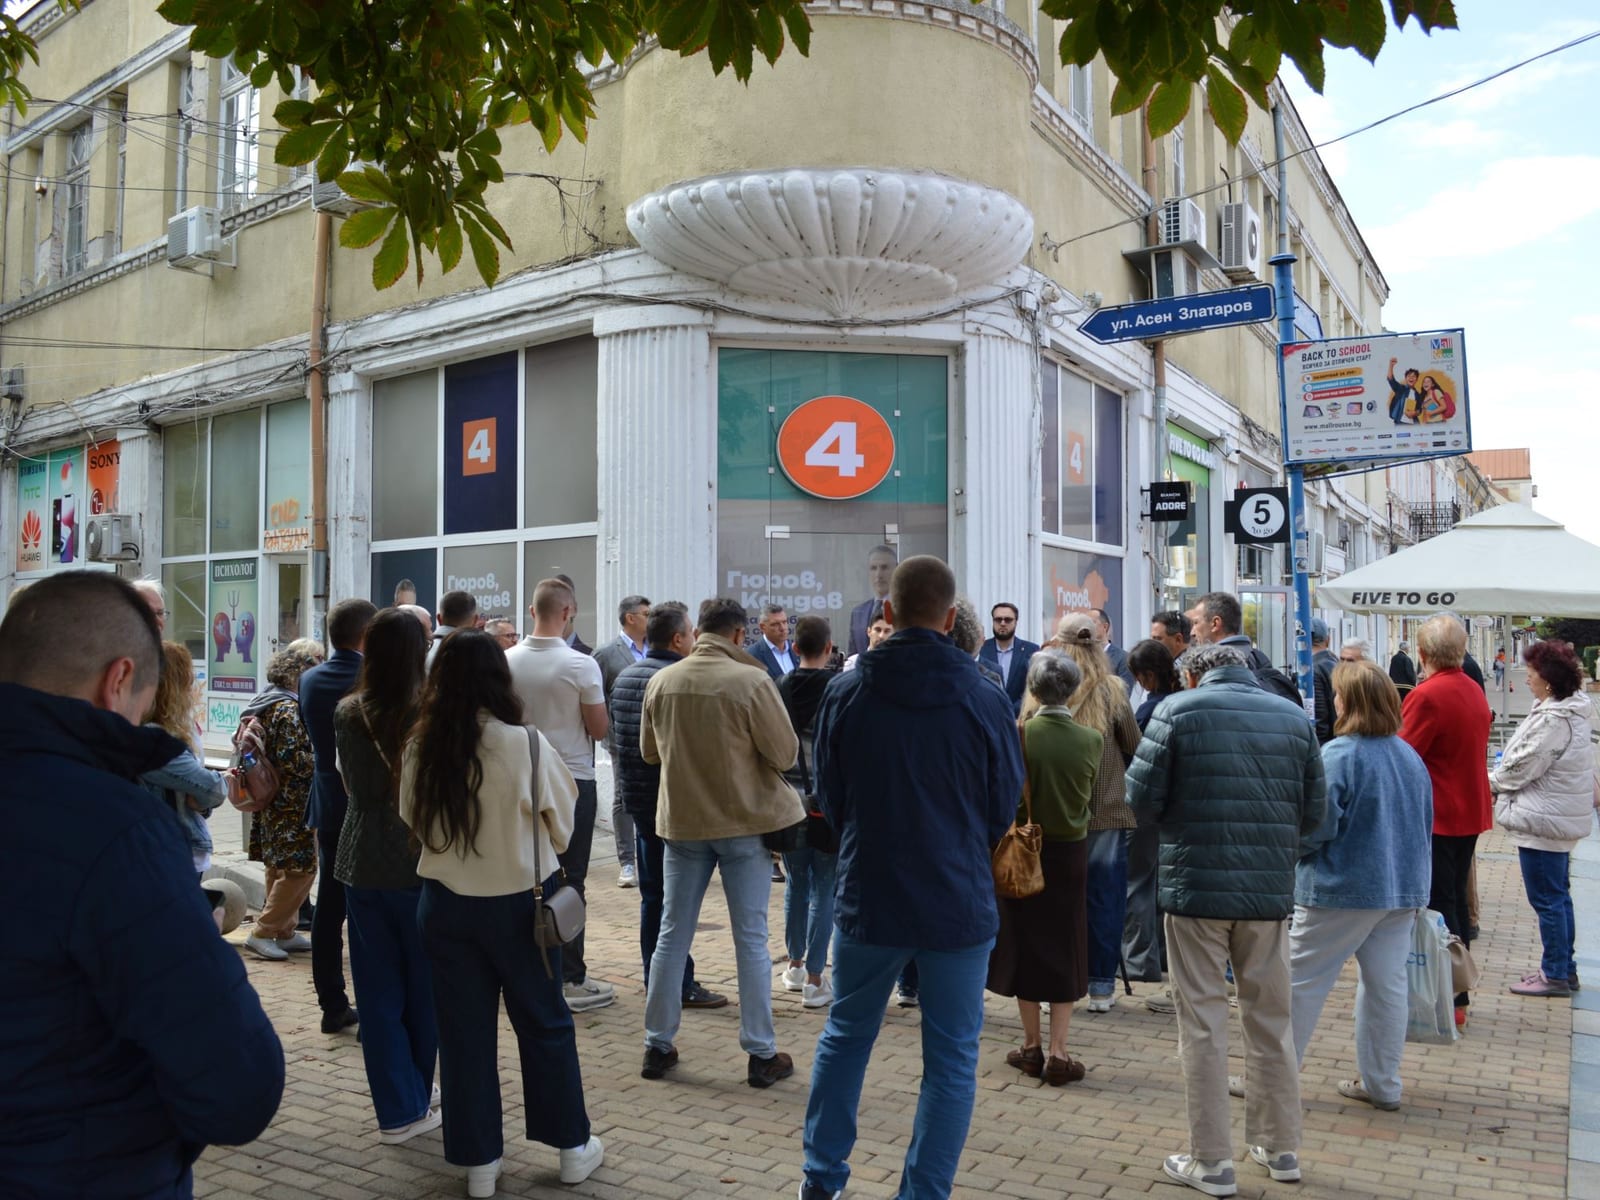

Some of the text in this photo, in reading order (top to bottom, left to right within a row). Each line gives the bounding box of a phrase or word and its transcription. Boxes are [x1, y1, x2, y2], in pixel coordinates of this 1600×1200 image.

[1111, 301, 1253, 334] ул. Асен Златаров
[1301, 343, 1372, 362] BACK TO SCHOOL
[468, 428, 491, 464] 4
[805, 421, 865, 477] 4
[90, 452, 120, 470] SONY
[1070, 441, 1082, 474] 4
[1155, 501, 1186, 511] ADORE
[1253, 500, 1271, 525] 5
[21, 551, 42, 562] HUAWEI
[214, 562, 255, 578] ПСИХОЛОГ
[447, 572, 499, 592] Гюров,
[727, 571, 823, 592] Гюров,
[1057, 586, 1091, 610] Гюров,
[1351, 592, 1456, 605] FIVE TO GO
